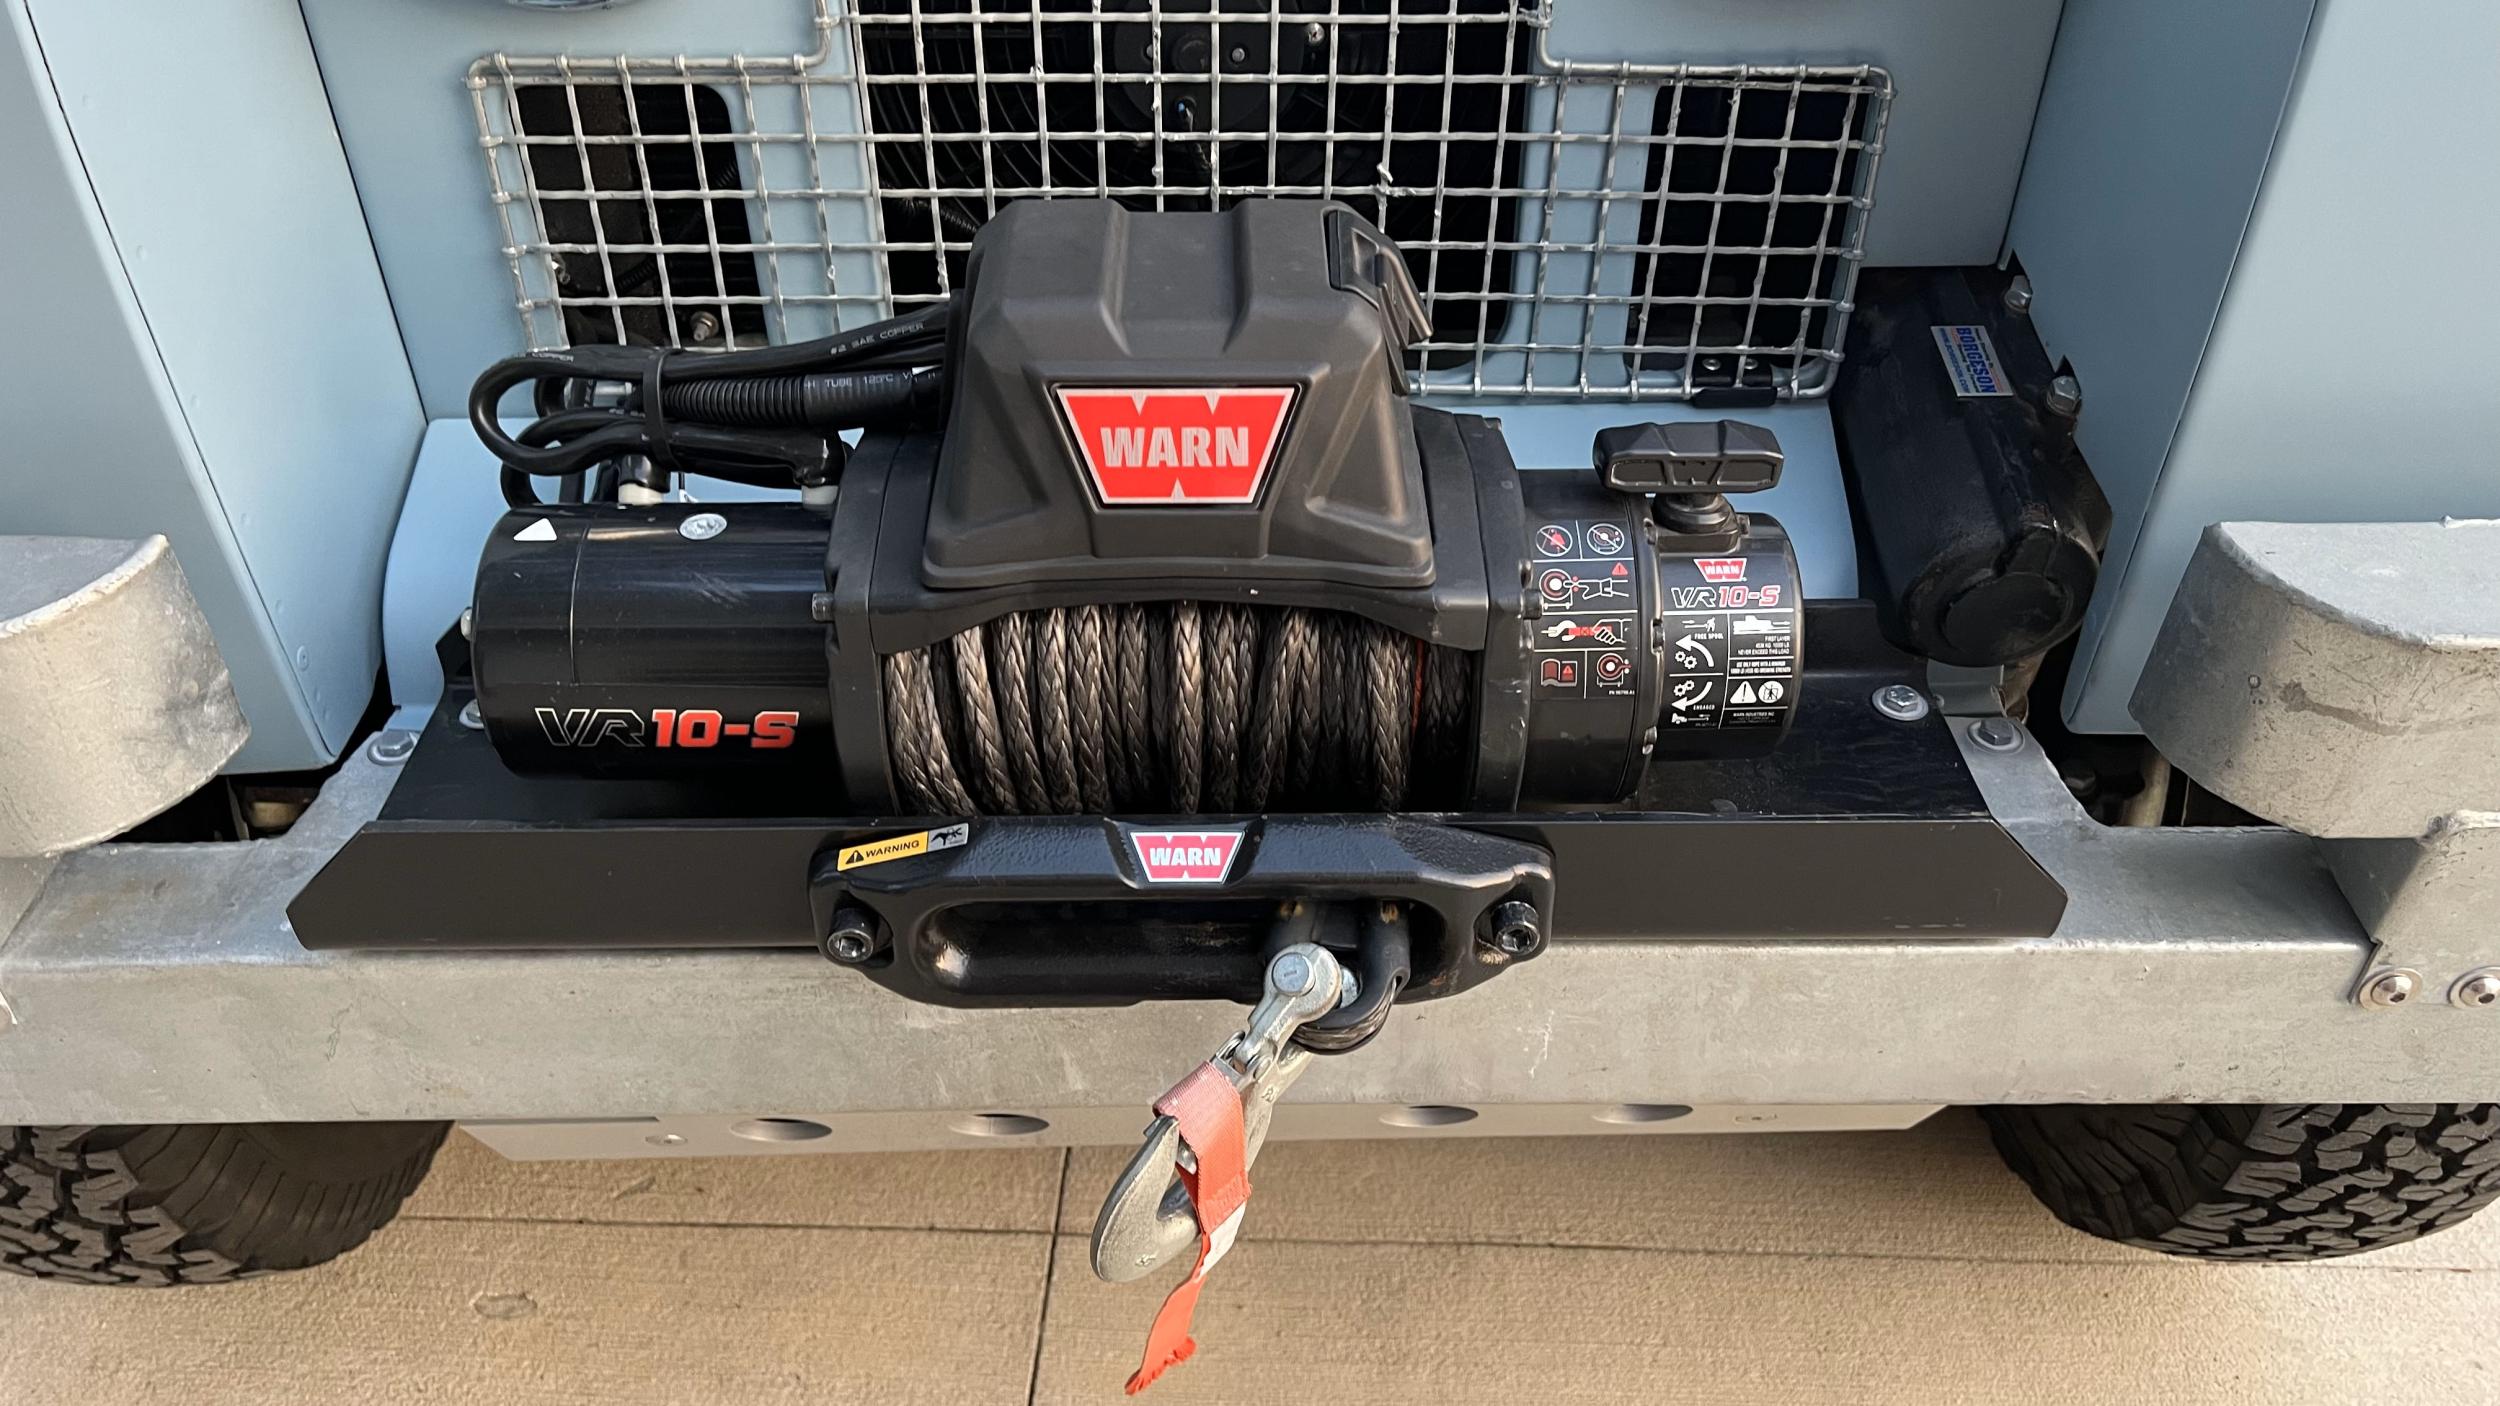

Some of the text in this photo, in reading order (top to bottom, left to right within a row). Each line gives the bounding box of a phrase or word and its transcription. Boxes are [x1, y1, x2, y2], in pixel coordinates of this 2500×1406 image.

[879, 321, 924, 339] COPPER
[1955, 327, 1998, 393] BORGESON
[1100, 426, 1249, 467] WARN
[1704, 565, 1740, 575] WARN
[866, 839, 920, 858] WARNING
[1149, 847, 1221, 866] WARN
